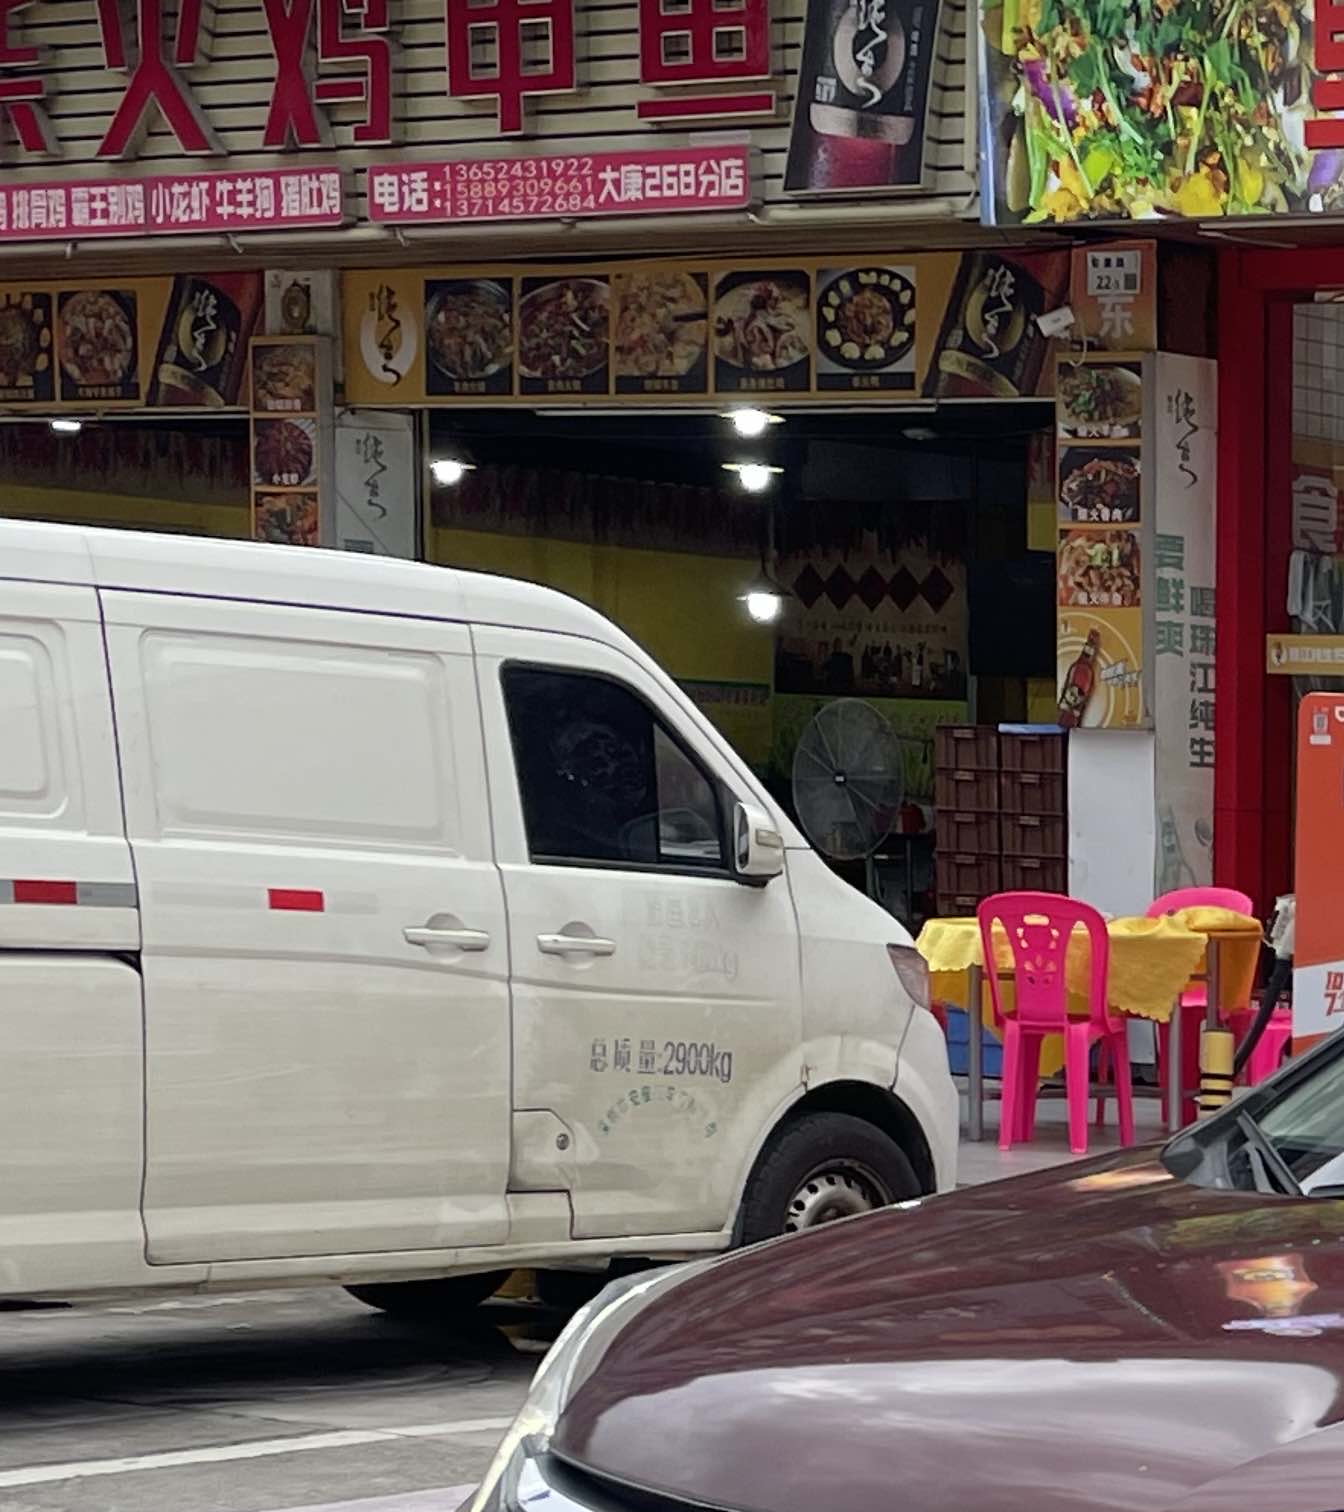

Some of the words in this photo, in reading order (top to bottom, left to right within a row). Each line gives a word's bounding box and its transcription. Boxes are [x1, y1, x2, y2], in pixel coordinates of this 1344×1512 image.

[443, 158, 593, 182] 13652431922
[598, 158, 744, 203] 大康268分店
[443, 177, 593, 200] 15889309661
[152, 181, 210, 223] 小龙虾
[443, 195, 595, 217] 13714572684
